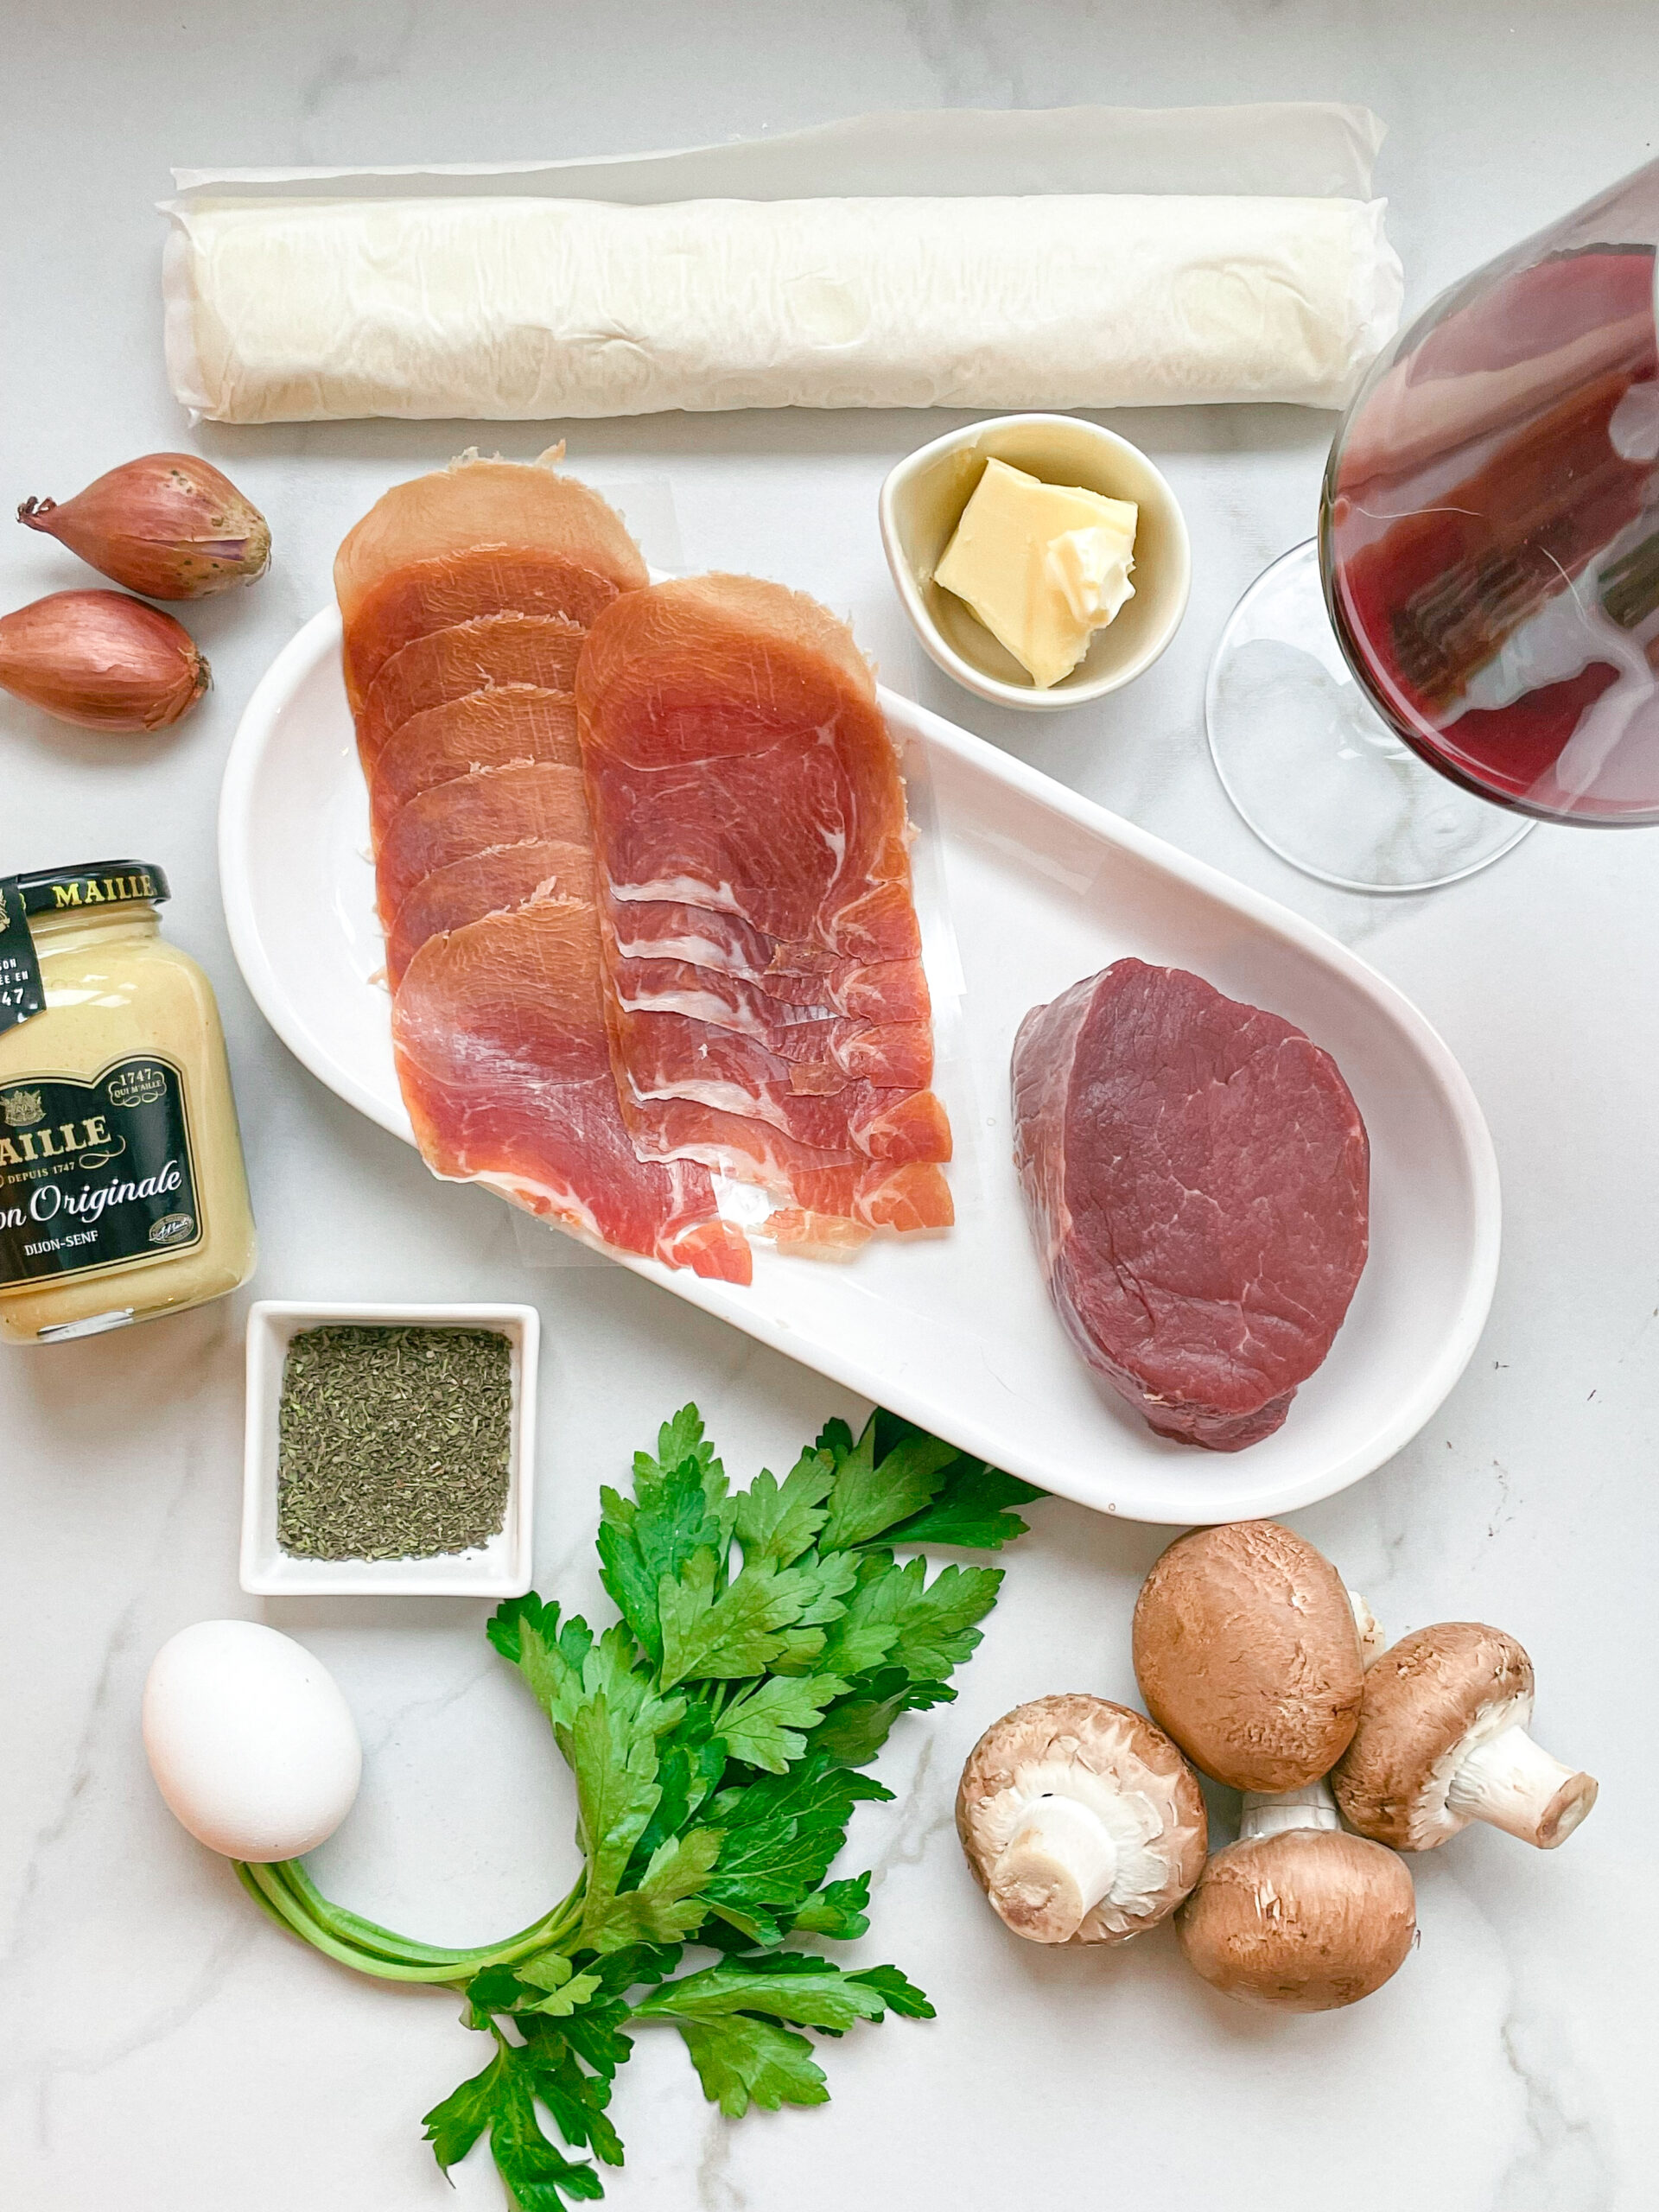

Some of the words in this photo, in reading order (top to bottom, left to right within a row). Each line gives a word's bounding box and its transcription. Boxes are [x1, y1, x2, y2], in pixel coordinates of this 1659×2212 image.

[51, 874, 156, 908] MAILLE
[15, 970, 29, 982] EN
[119, 1068, 152, 1085] 1747
[114, 1087, 130, 1098] QUI
[7, 1166, 49, 1185] DEPUIS
[53, 1161, 76, 1175] 1747
[29, 1160, 182, 1224] Originale
[23, 1230, 99, 1256] DIJON-SENF
